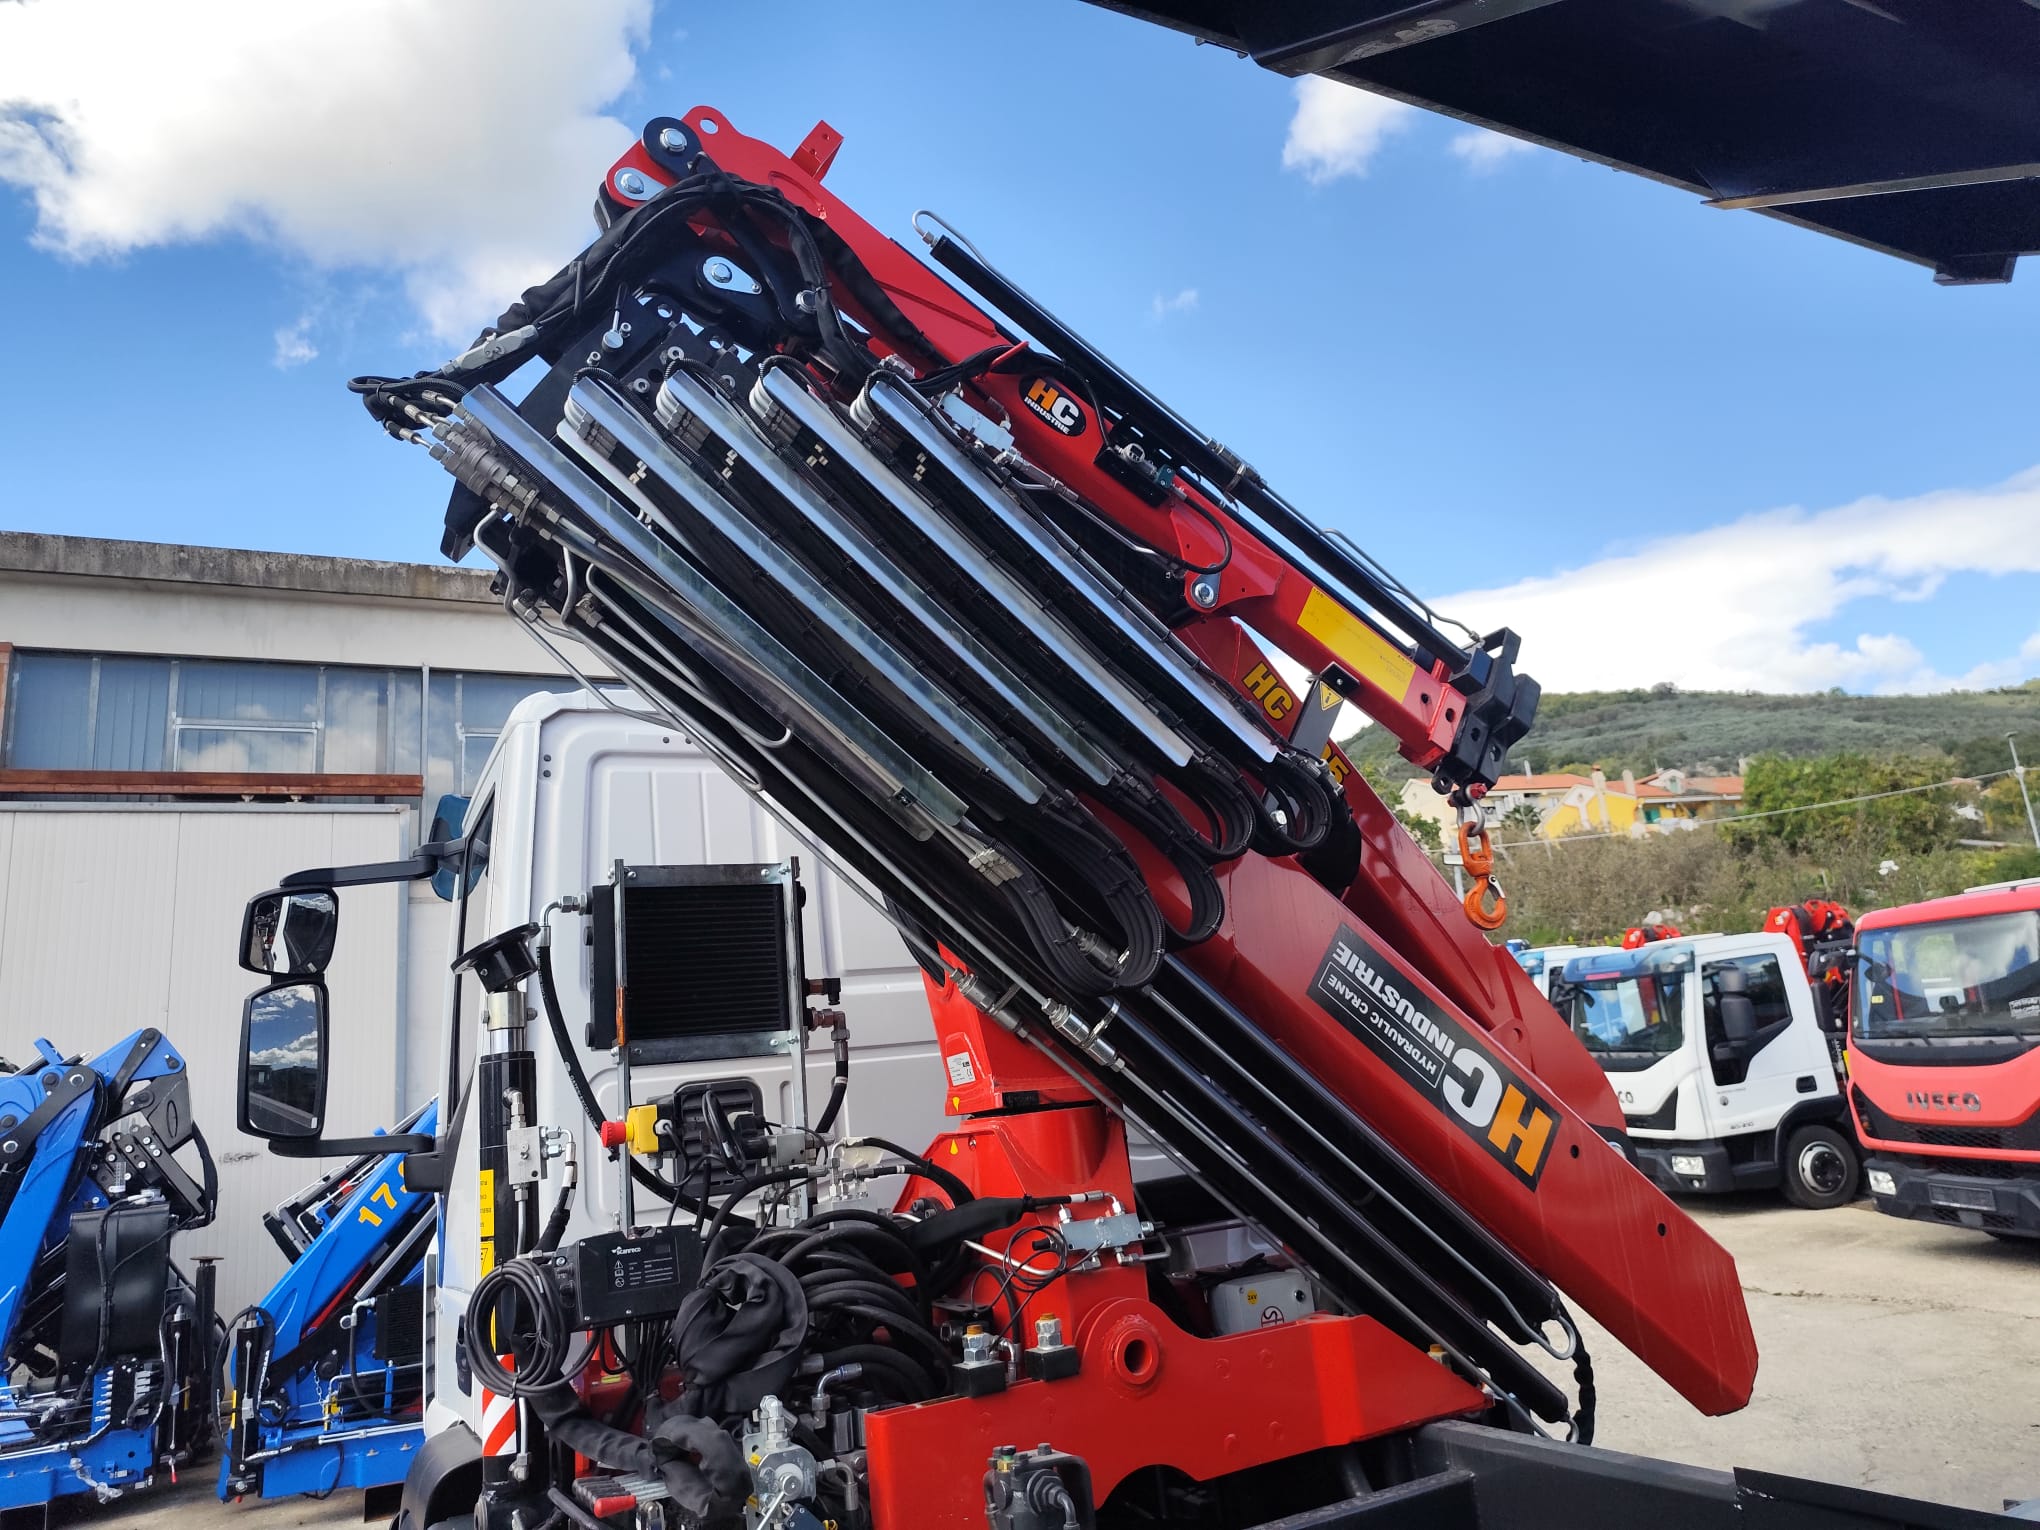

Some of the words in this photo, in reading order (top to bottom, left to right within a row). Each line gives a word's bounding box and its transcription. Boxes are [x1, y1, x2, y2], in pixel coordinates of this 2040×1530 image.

[1024, 396, 1070, 434] INDUSTRIE
[1028, 378, 1079, 426] HC
[1243, 662, 1293, 720] HC
[1327, 973, 1368, 1014] CRANE
[1332, 941, 1455, 1059] INDUSTRIE
[1369, 1011, 1437, 1075] HYDRAULIC
[1442, 1048, 1552, 1177] HC
[1906, 1091, 1981, 1112] IVECO
